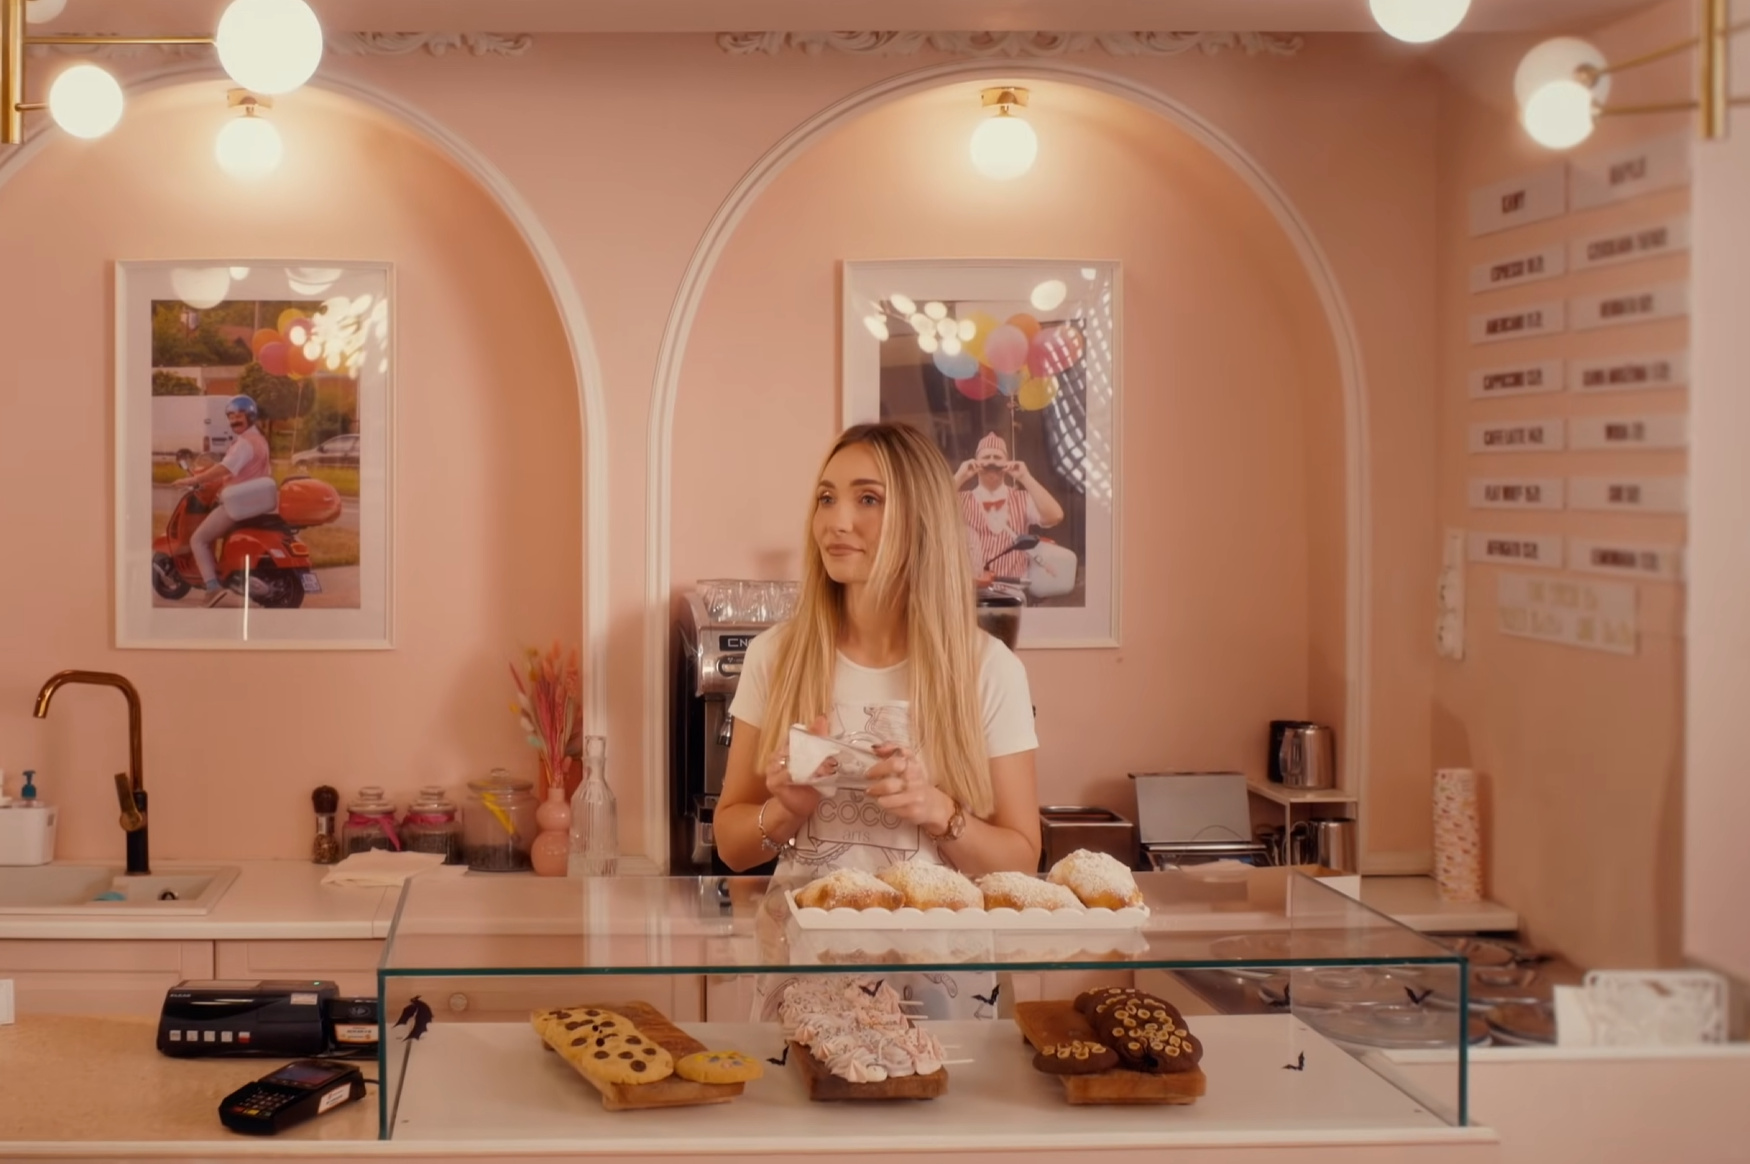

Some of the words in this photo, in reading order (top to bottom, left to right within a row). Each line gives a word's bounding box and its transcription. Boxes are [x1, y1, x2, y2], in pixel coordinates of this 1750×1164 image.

[727, 638, 751, 647] CN
[817, 798, 901, 830] COCO
[843, 829, 870, 842] arts
